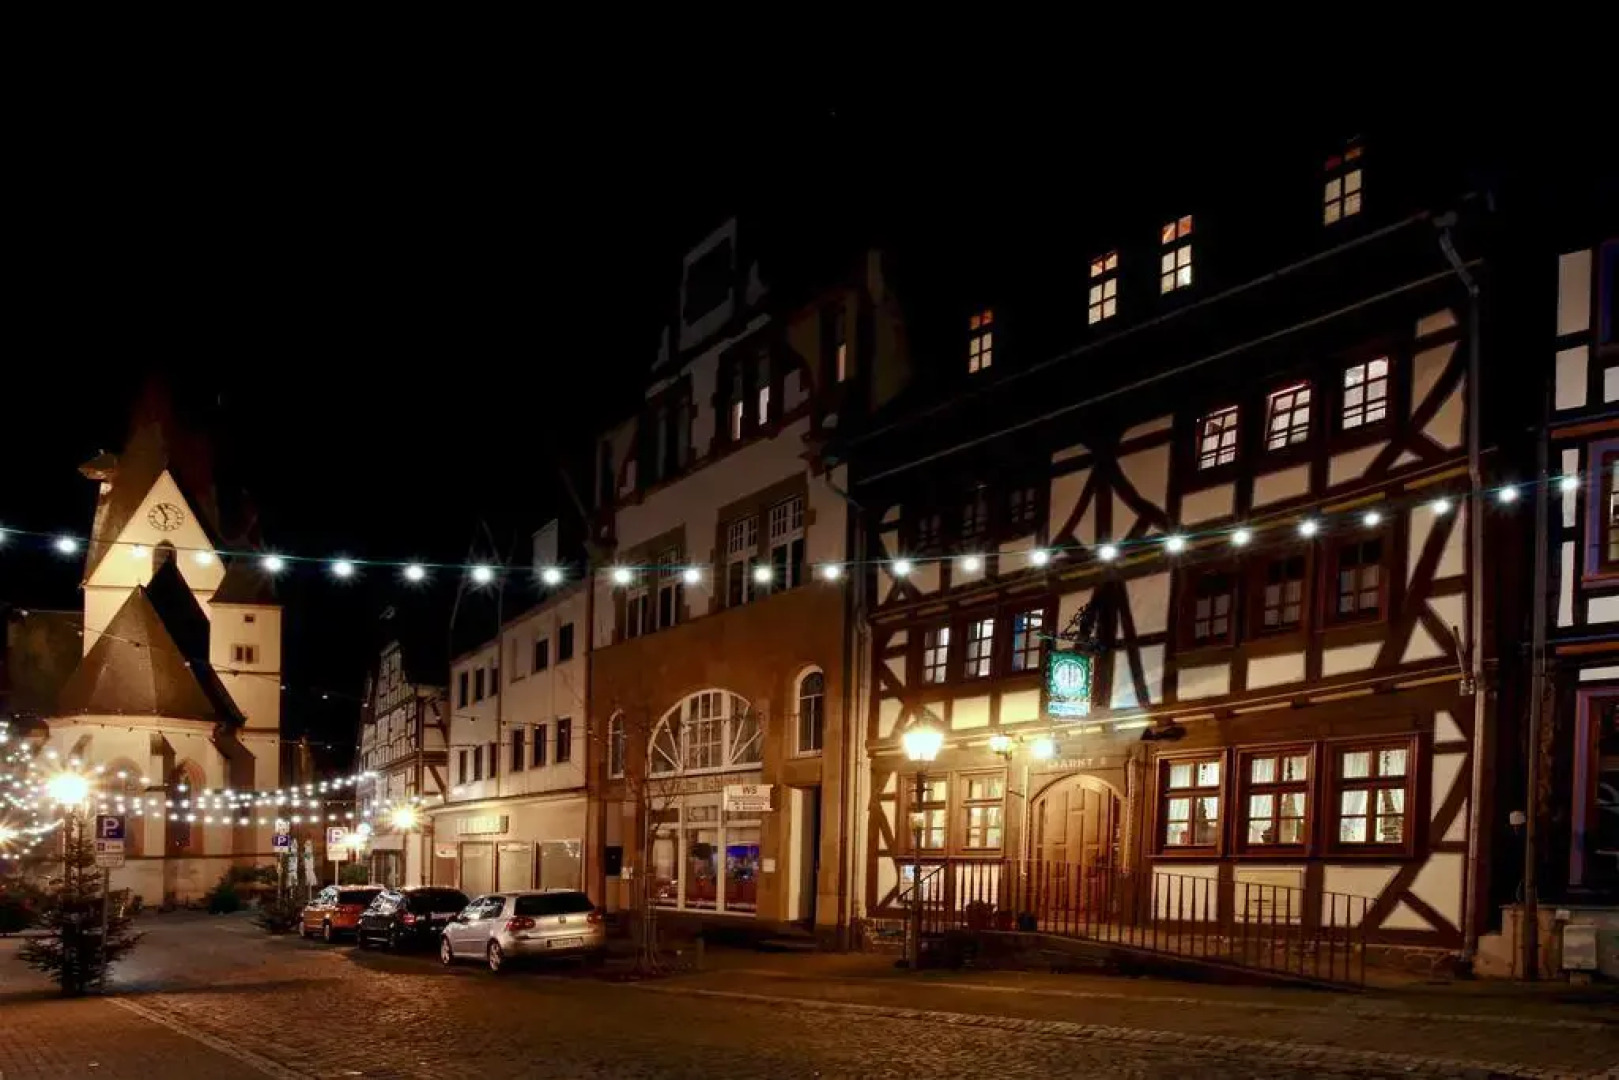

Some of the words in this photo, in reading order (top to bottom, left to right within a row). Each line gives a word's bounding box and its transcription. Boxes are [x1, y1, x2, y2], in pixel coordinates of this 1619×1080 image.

[103, 817, 120, 836] P
[277, 836, 287, 846] P
[331, 829, 344, 842] P
